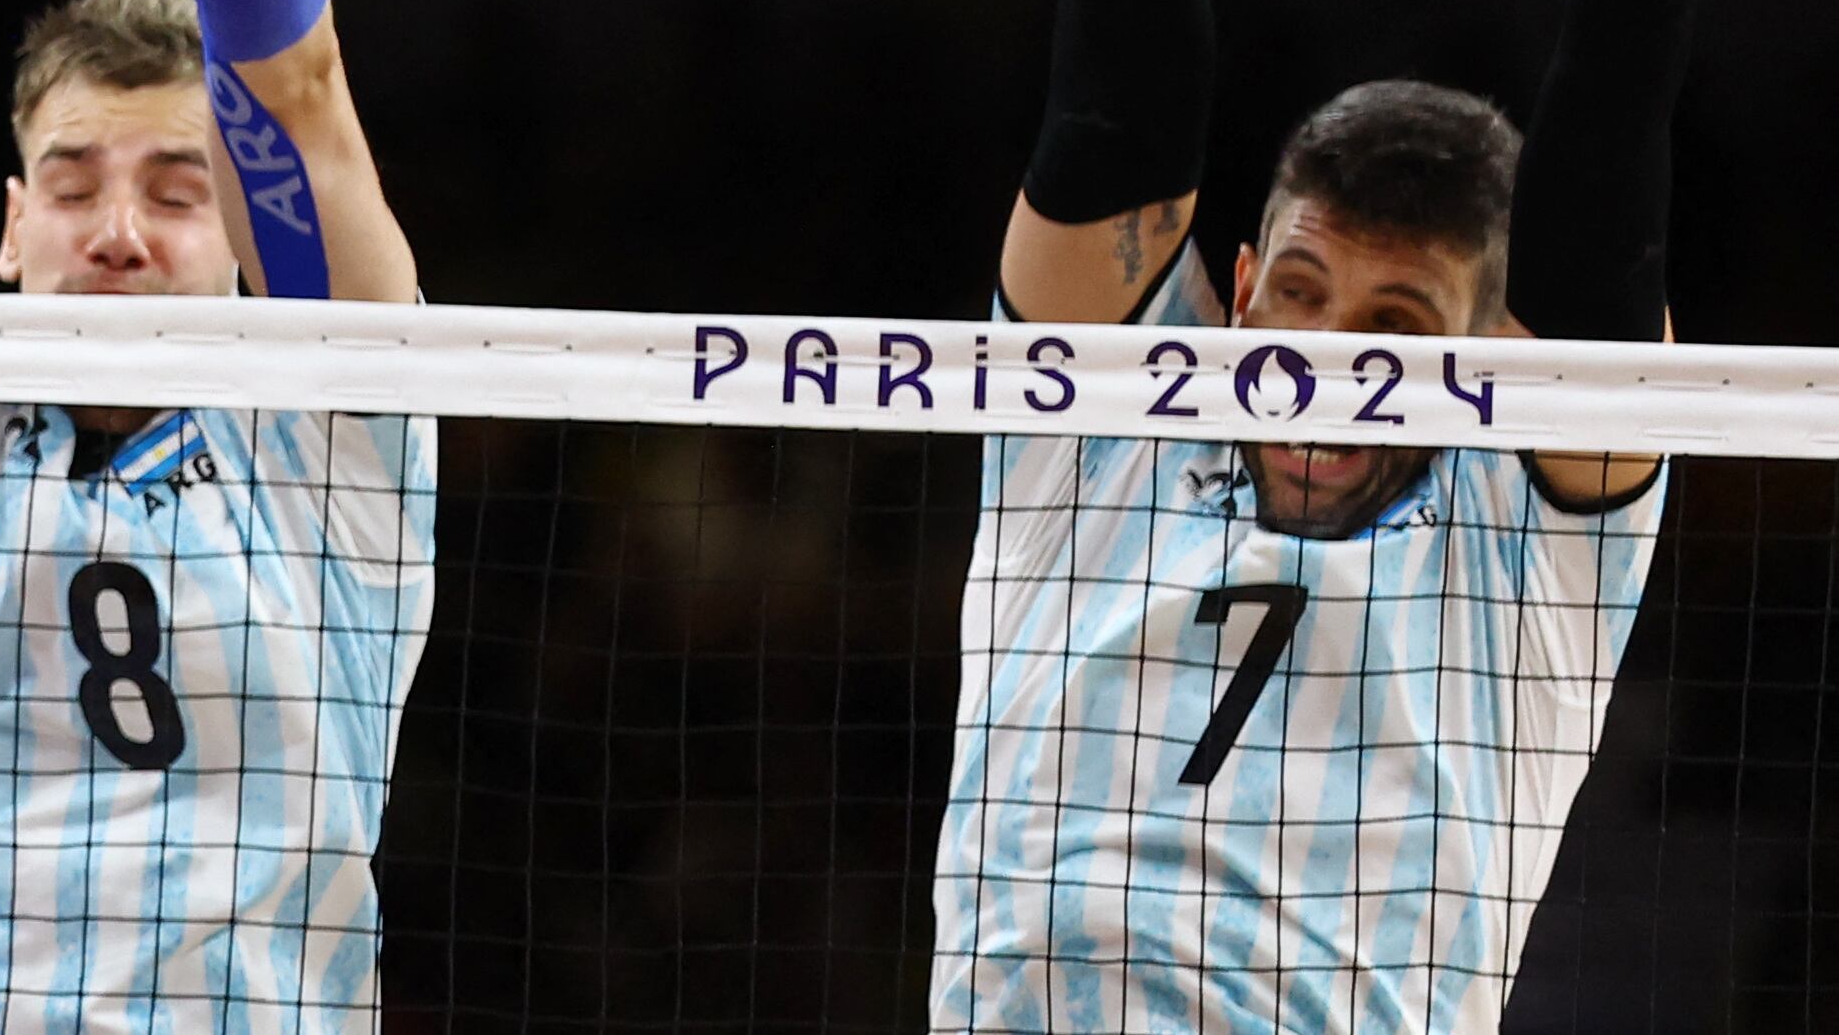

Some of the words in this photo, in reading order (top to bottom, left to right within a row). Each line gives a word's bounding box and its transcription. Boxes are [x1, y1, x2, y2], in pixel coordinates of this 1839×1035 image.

[143, 453, 216, 517] ARG
[68, 562, 186, 770] 8
[1177, 584, 1309, 787] 7
